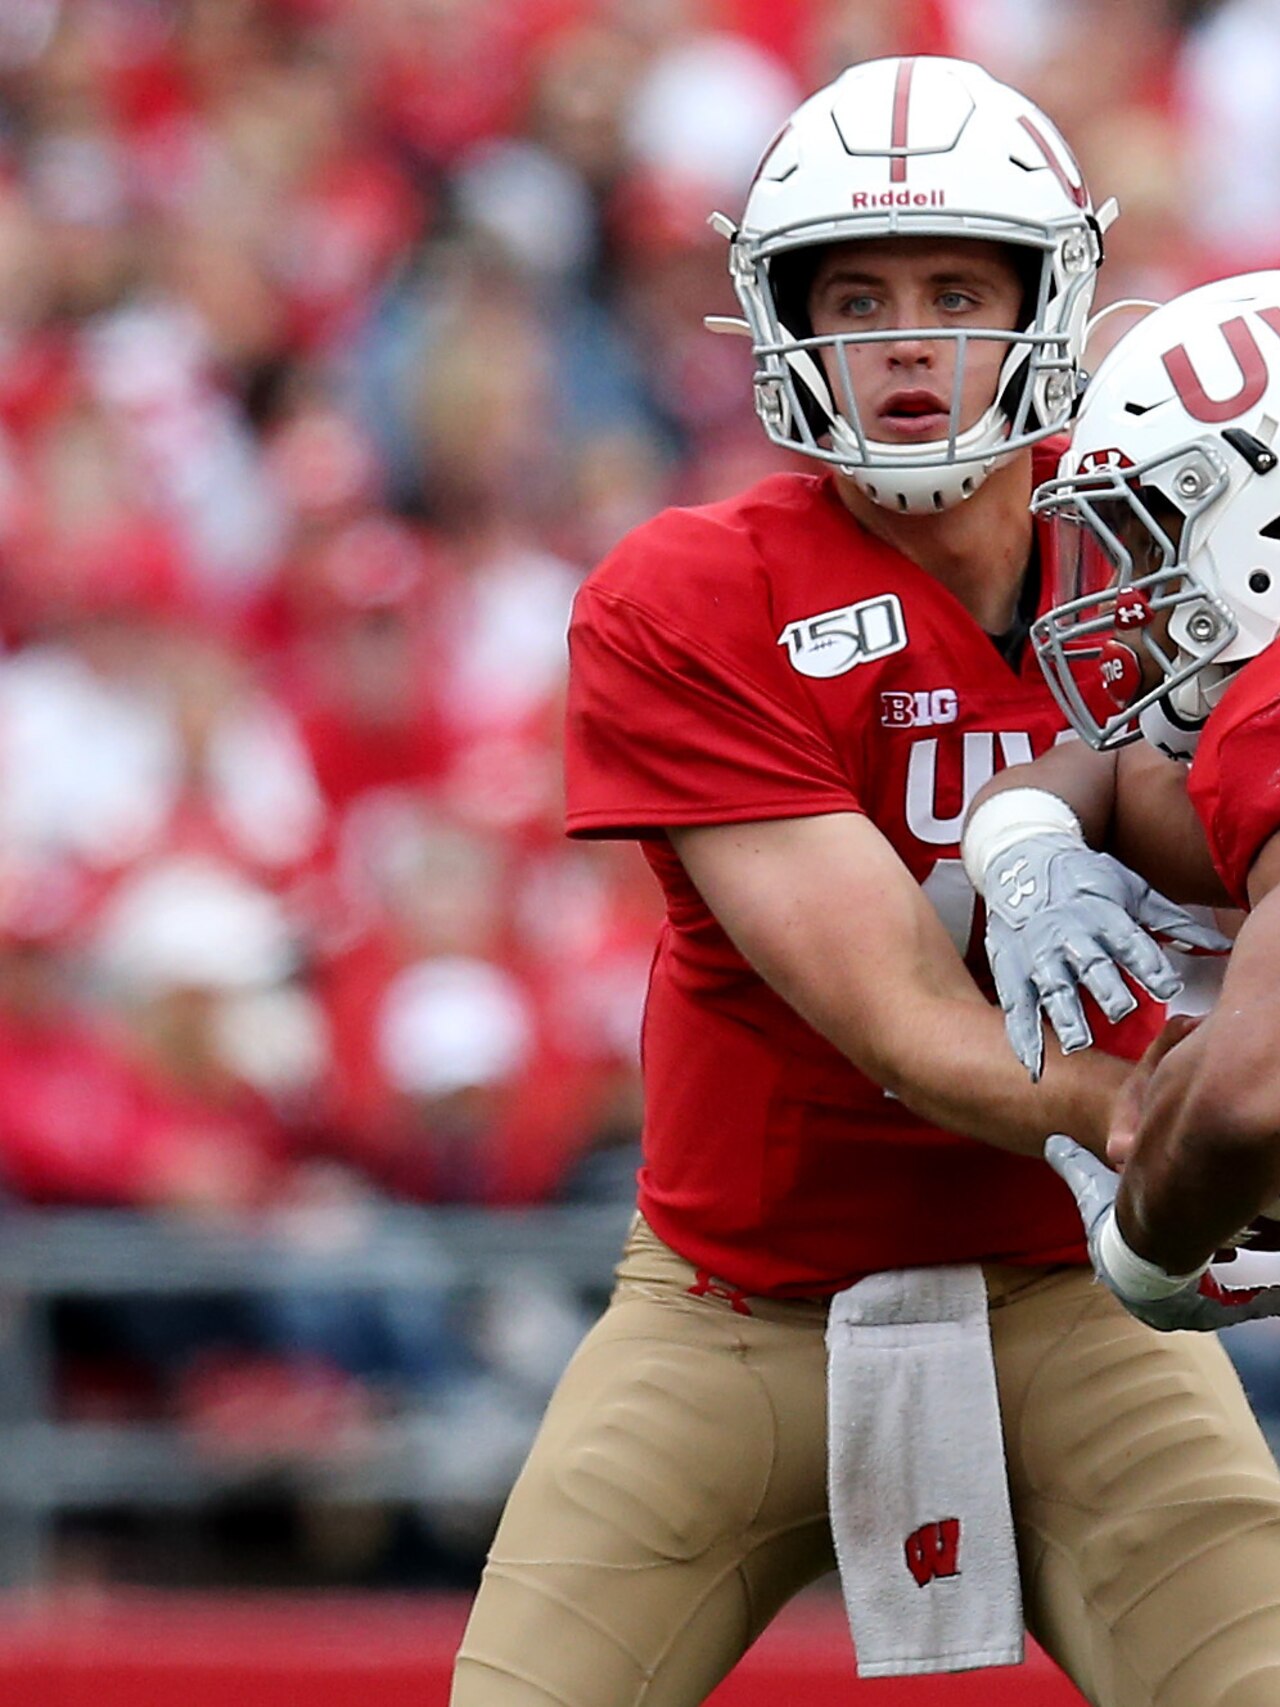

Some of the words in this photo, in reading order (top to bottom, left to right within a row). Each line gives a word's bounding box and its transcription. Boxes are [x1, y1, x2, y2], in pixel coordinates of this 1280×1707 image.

[852, 189, 945, 210] Riddell
[784, 596, 903, 672] 150
[904, 1517, 961, 1589] W
